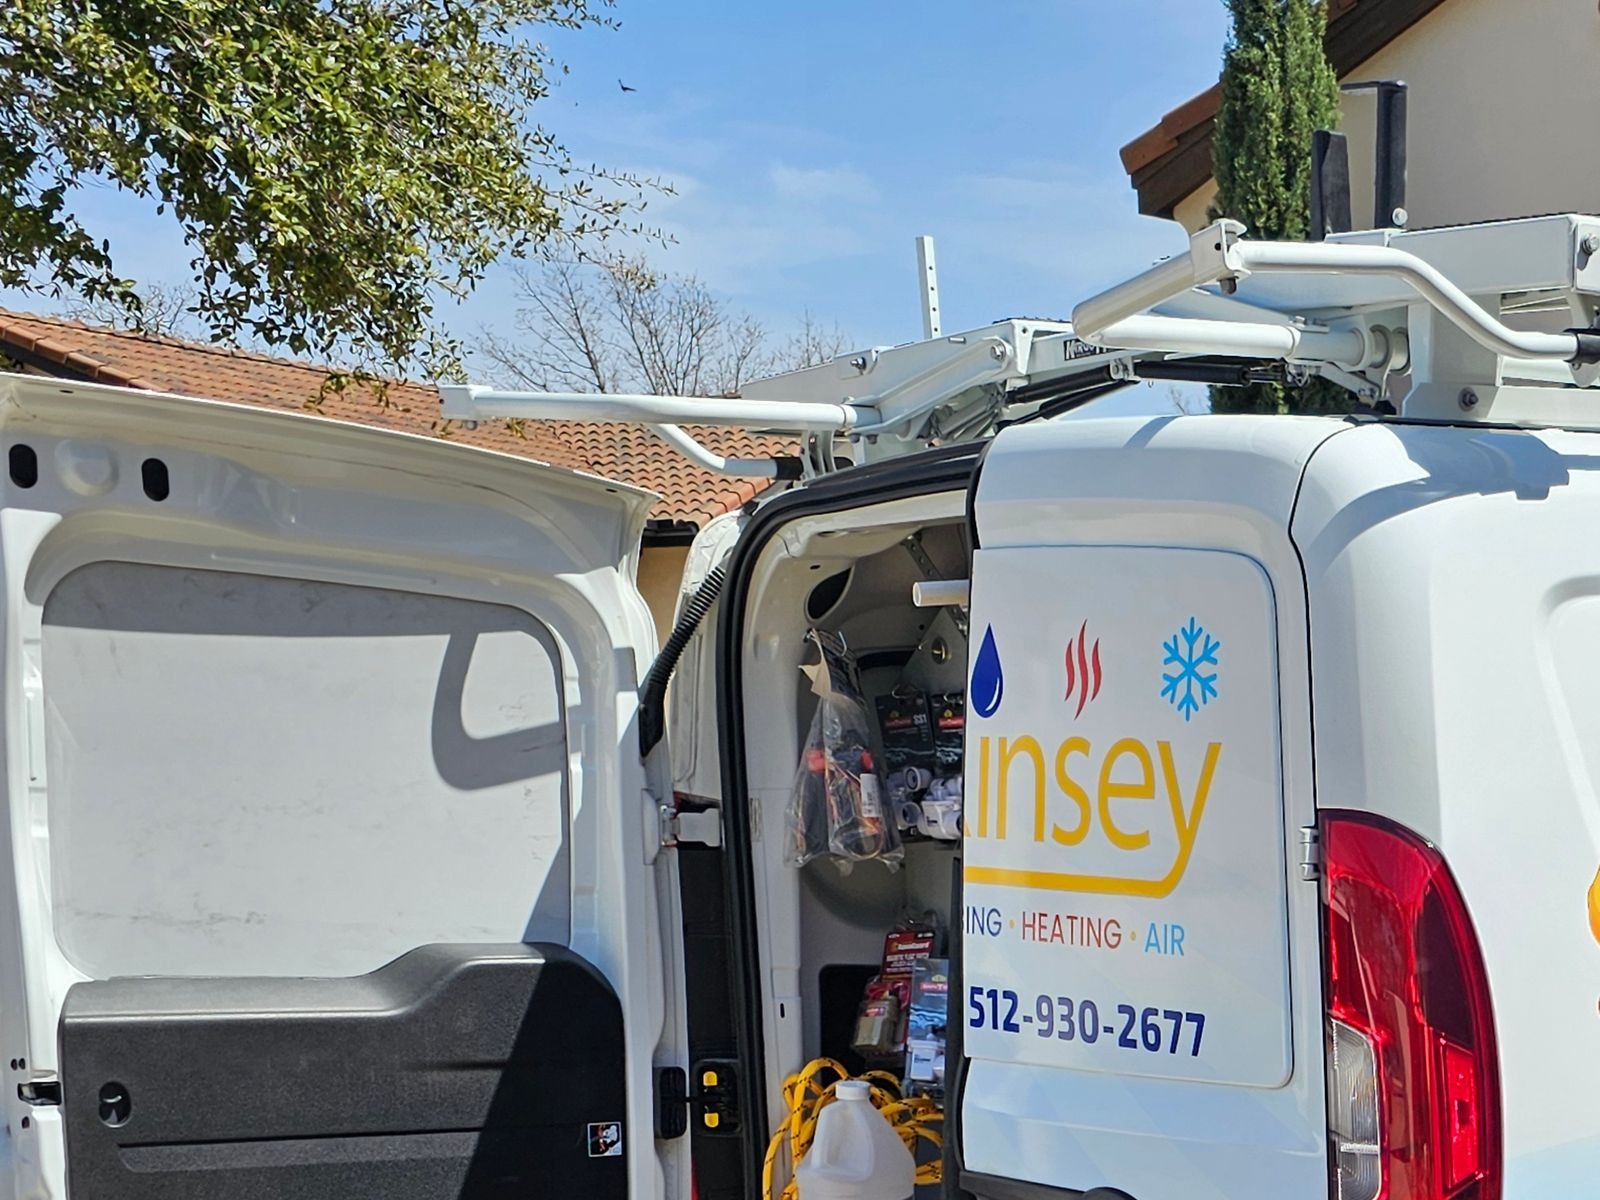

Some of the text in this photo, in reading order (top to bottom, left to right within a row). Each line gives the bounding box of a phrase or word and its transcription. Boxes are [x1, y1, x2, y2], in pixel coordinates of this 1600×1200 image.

[965, 734, 1223, 899] insey
[1021, 911, 1122, 950] HEATING
[1144, 922, 1186, 957] AIR
[969, 985, 1207, 1058] 512-930-2677
